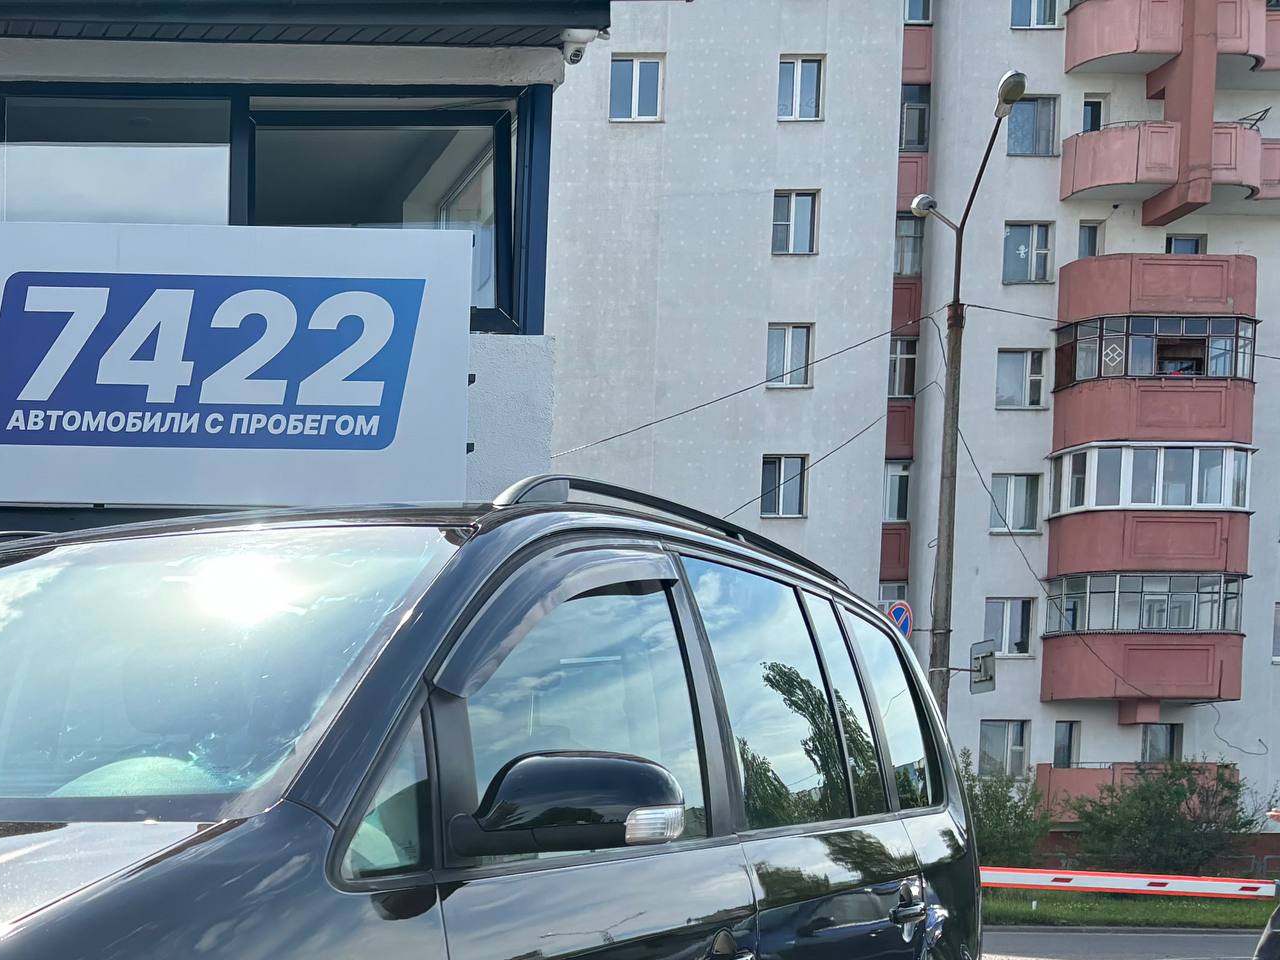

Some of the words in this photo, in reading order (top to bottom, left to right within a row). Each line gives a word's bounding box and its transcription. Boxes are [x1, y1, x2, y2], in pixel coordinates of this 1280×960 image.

[17, 286, 395, 406] 7422
[6, 409, 200, 433] АВТОМОБИЛИ
[205, 413, 222, 433] С
[229, 413, 380, 436] ПРОБЕГОМ
